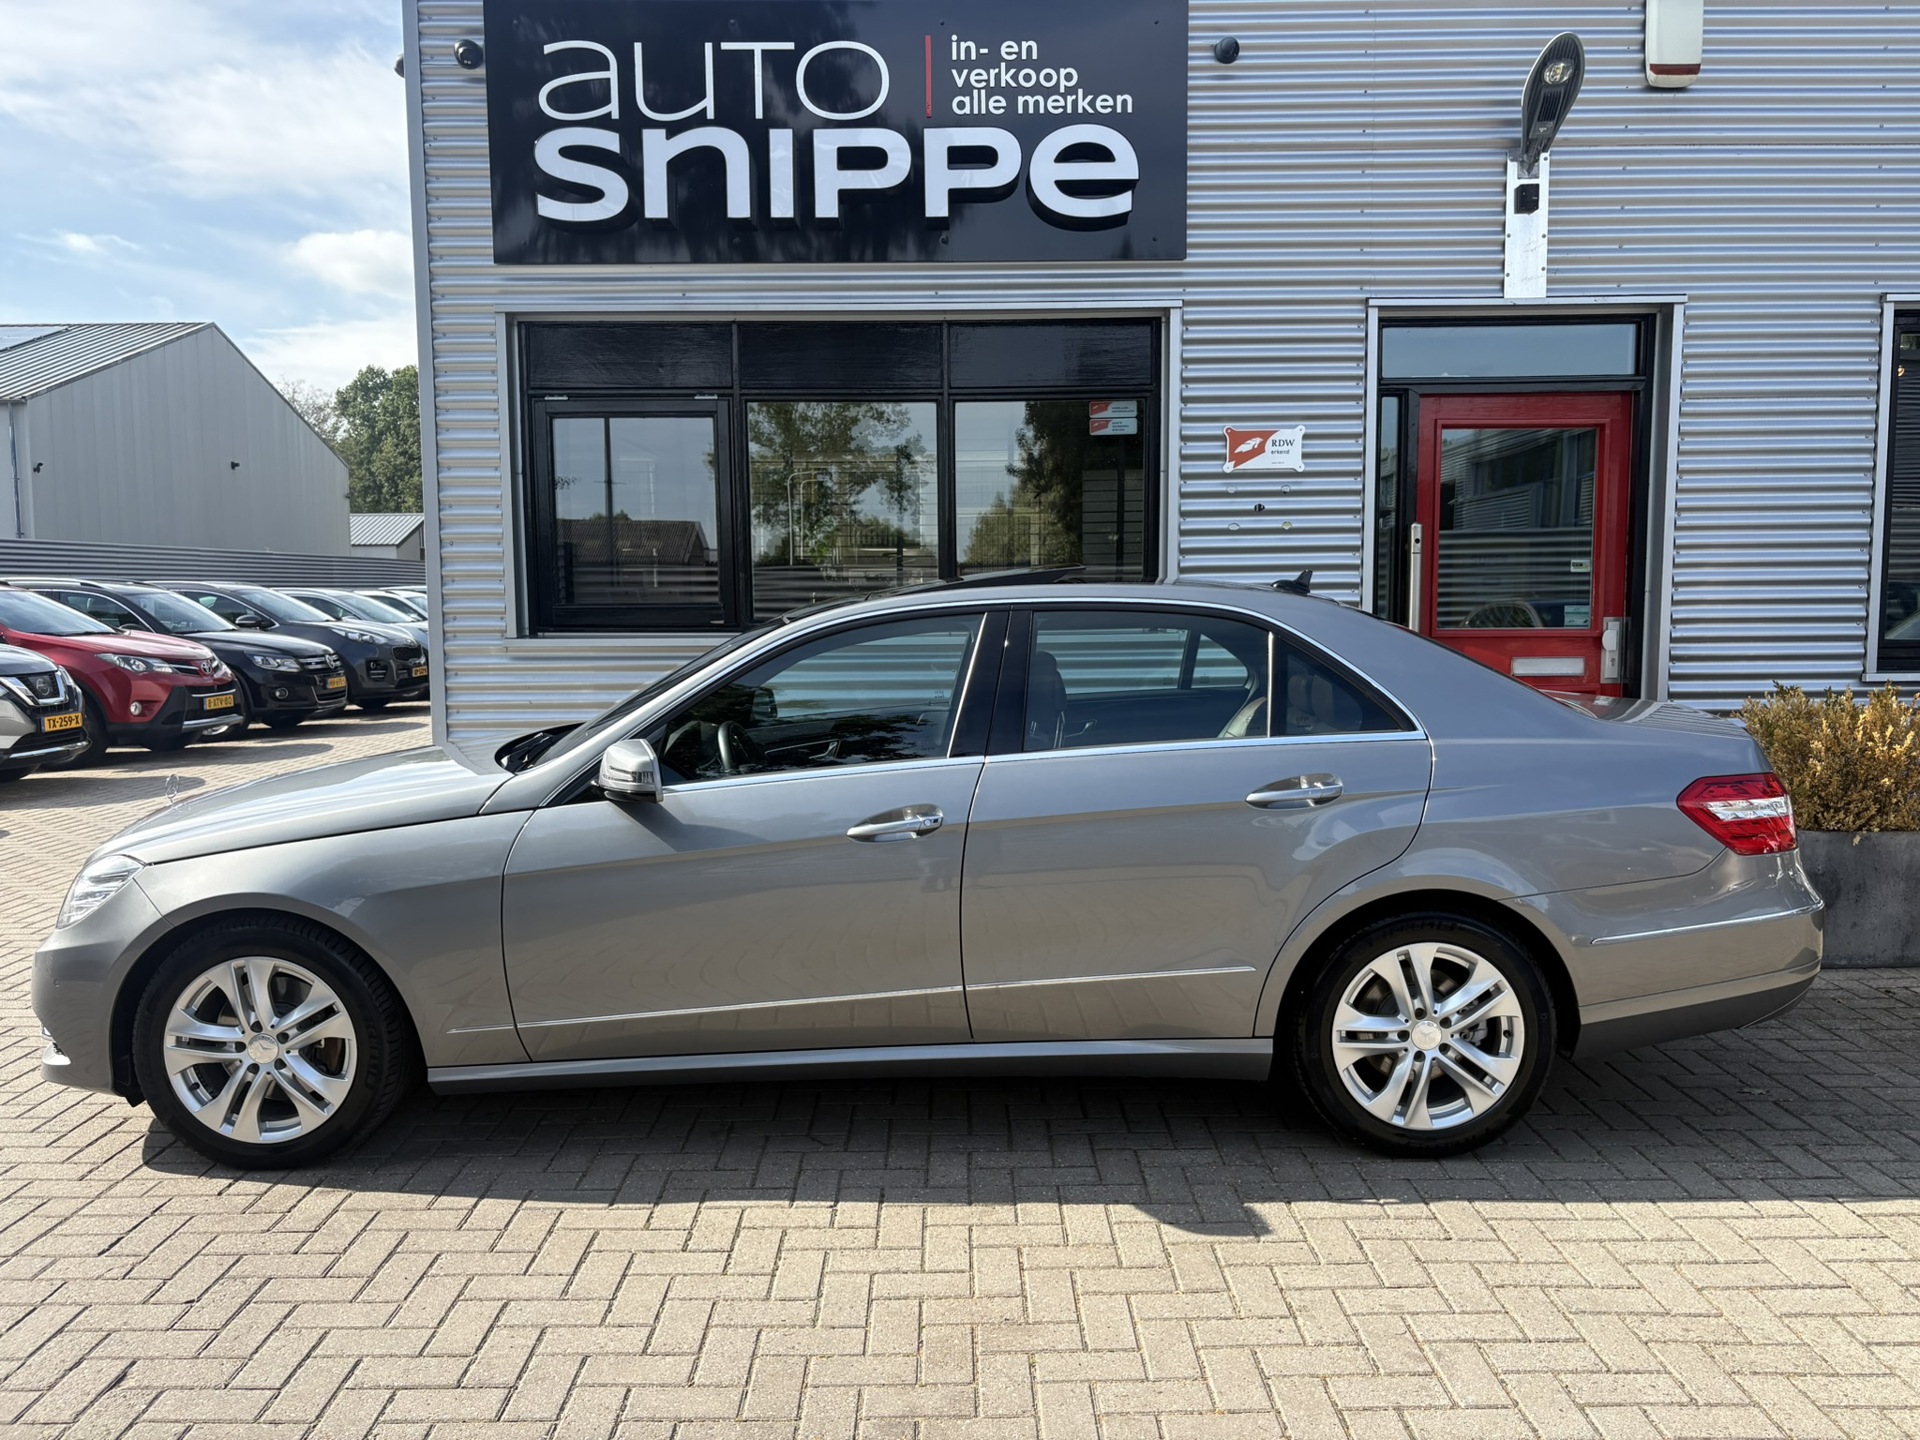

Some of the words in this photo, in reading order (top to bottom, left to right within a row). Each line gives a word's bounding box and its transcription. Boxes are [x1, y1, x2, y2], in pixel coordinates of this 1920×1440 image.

[951, 34, 989, 61] in-
[1000, 40, 1038, 60] en
[951, 62, 1079, 93] verkoop
[952, 89, 1007, 115] alle
[1017, 88, 1133, 114] merken
[1271, 438, 1295, 447] RDW
[46, 714, 80, 729] TX-259-X
